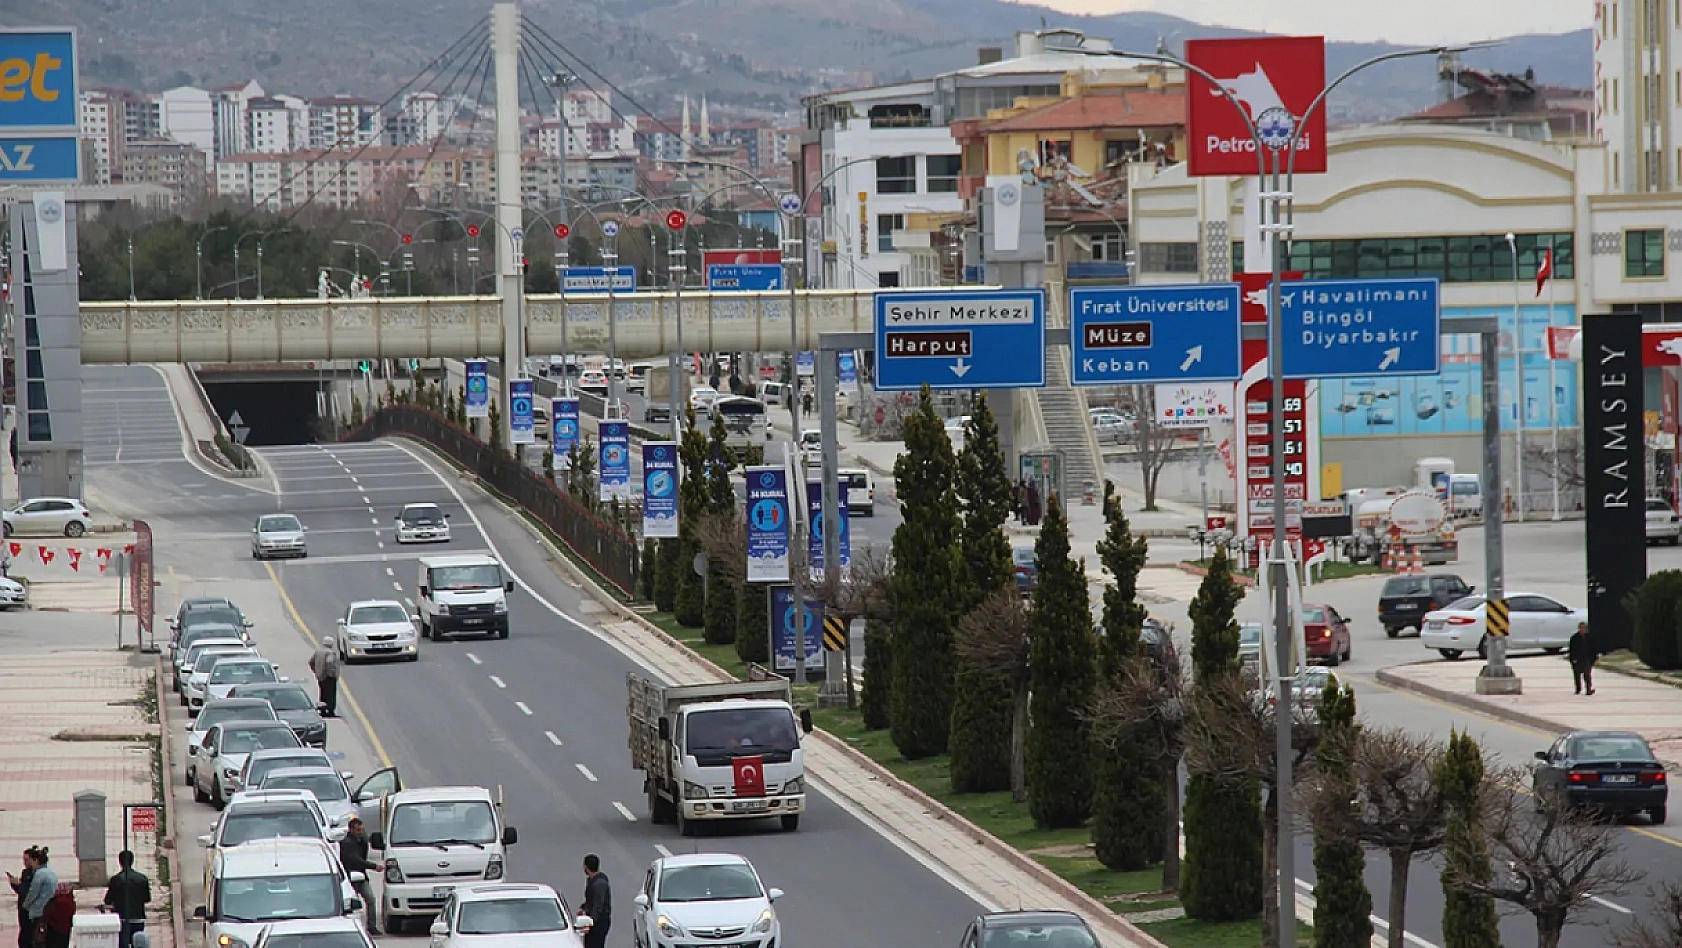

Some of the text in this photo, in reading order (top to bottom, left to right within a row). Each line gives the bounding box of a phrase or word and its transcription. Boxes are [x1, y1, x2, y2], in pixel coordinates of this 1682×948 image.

[1207, 134, 1262, 153] Petro
[1081, 296, 1230, 315] Fırat Üniversitesi
[1302, 289, 1428, 305] Havalimanı
[890, 305, 1029, 323] Şehir Merkezi
[1302, 308, 1373, 327] Bingöl
[1088, 328, 1147, 344] Müze
[1302, 328, 1419, 349] Diyarbakır
[892, 337, 968, 355] Harput
[1082, 358, 1150, 373] Keban
[1281, 398, 1302, 412] .69
[1282, 419, 1302, 434] .57
[1601, 344, 1629, 508] RAMSEY
[1282, 441, 1302, 454] .61
[1250, 484, 1303, 497] Maet
